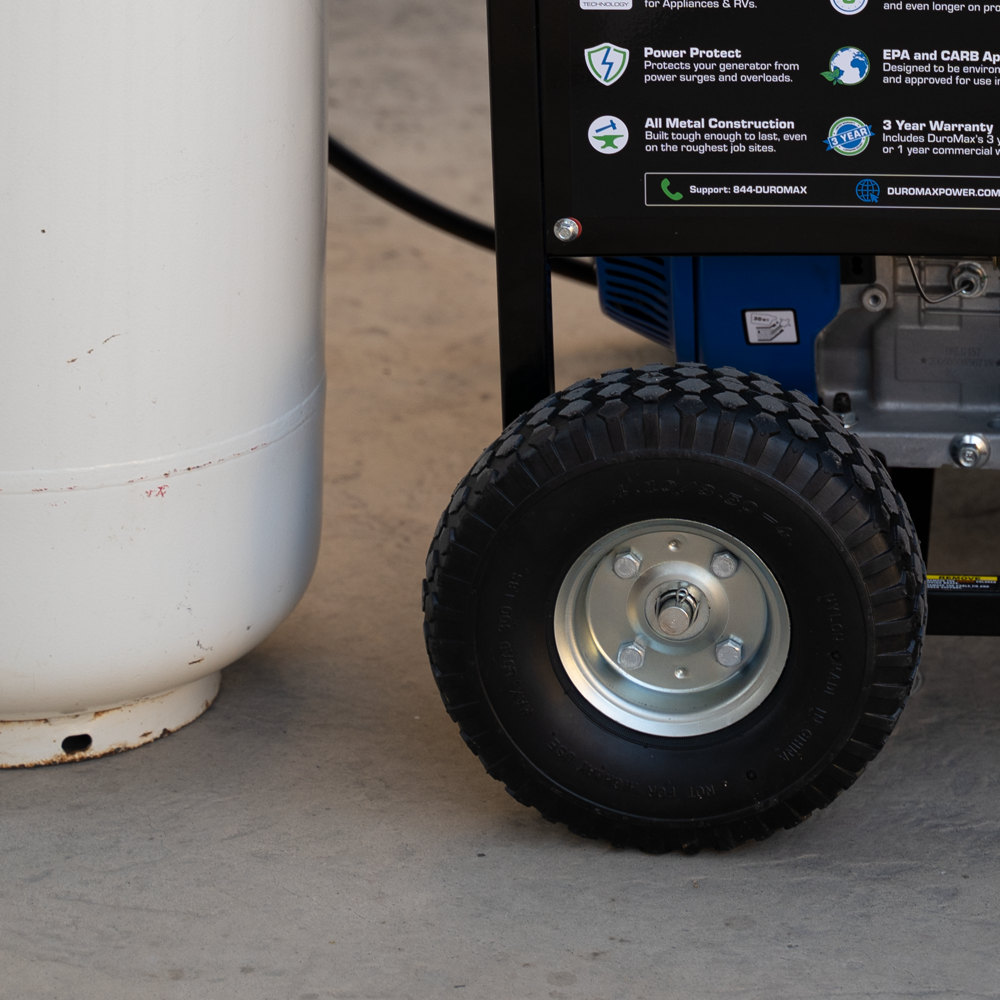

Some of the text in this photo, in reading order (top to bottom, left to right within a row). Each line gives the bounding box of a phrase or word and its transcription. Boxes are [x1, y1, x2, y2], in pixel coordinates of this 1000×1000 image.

[644, 47, 742, 58] Power Protect
[883, 49, 910, 60] EPA
[913, 50, 937, 61] and
[941, 50, 979, 61] CARB
[644, 60, 799, 72] Protects your generator from
[883, 62, 931, 74] Designed
[933, 64, 944, 73] to
[947, 64, 960, 73] be
[645, 117, 795, 129] All Metal Construction
[883, 119, 994, 135] 3 Year Warranty
[645, 131, 669, 140] Built
[671, 131, 701, 142] tough
[704, 131, 742, 143] enough
[758, 131, 780, 141] last,
[831, 127, 868, 146] 3 YEAR
[883, 133, 925, 142] Includes
[927, 133, 984, 144] DuroMax's
[986, 135, 994, 144] 3
[690, 185, 807, 195] Support: 844-DUROMAX
[887, 187, 1000, 197] DUROMAXPOWER.COM
